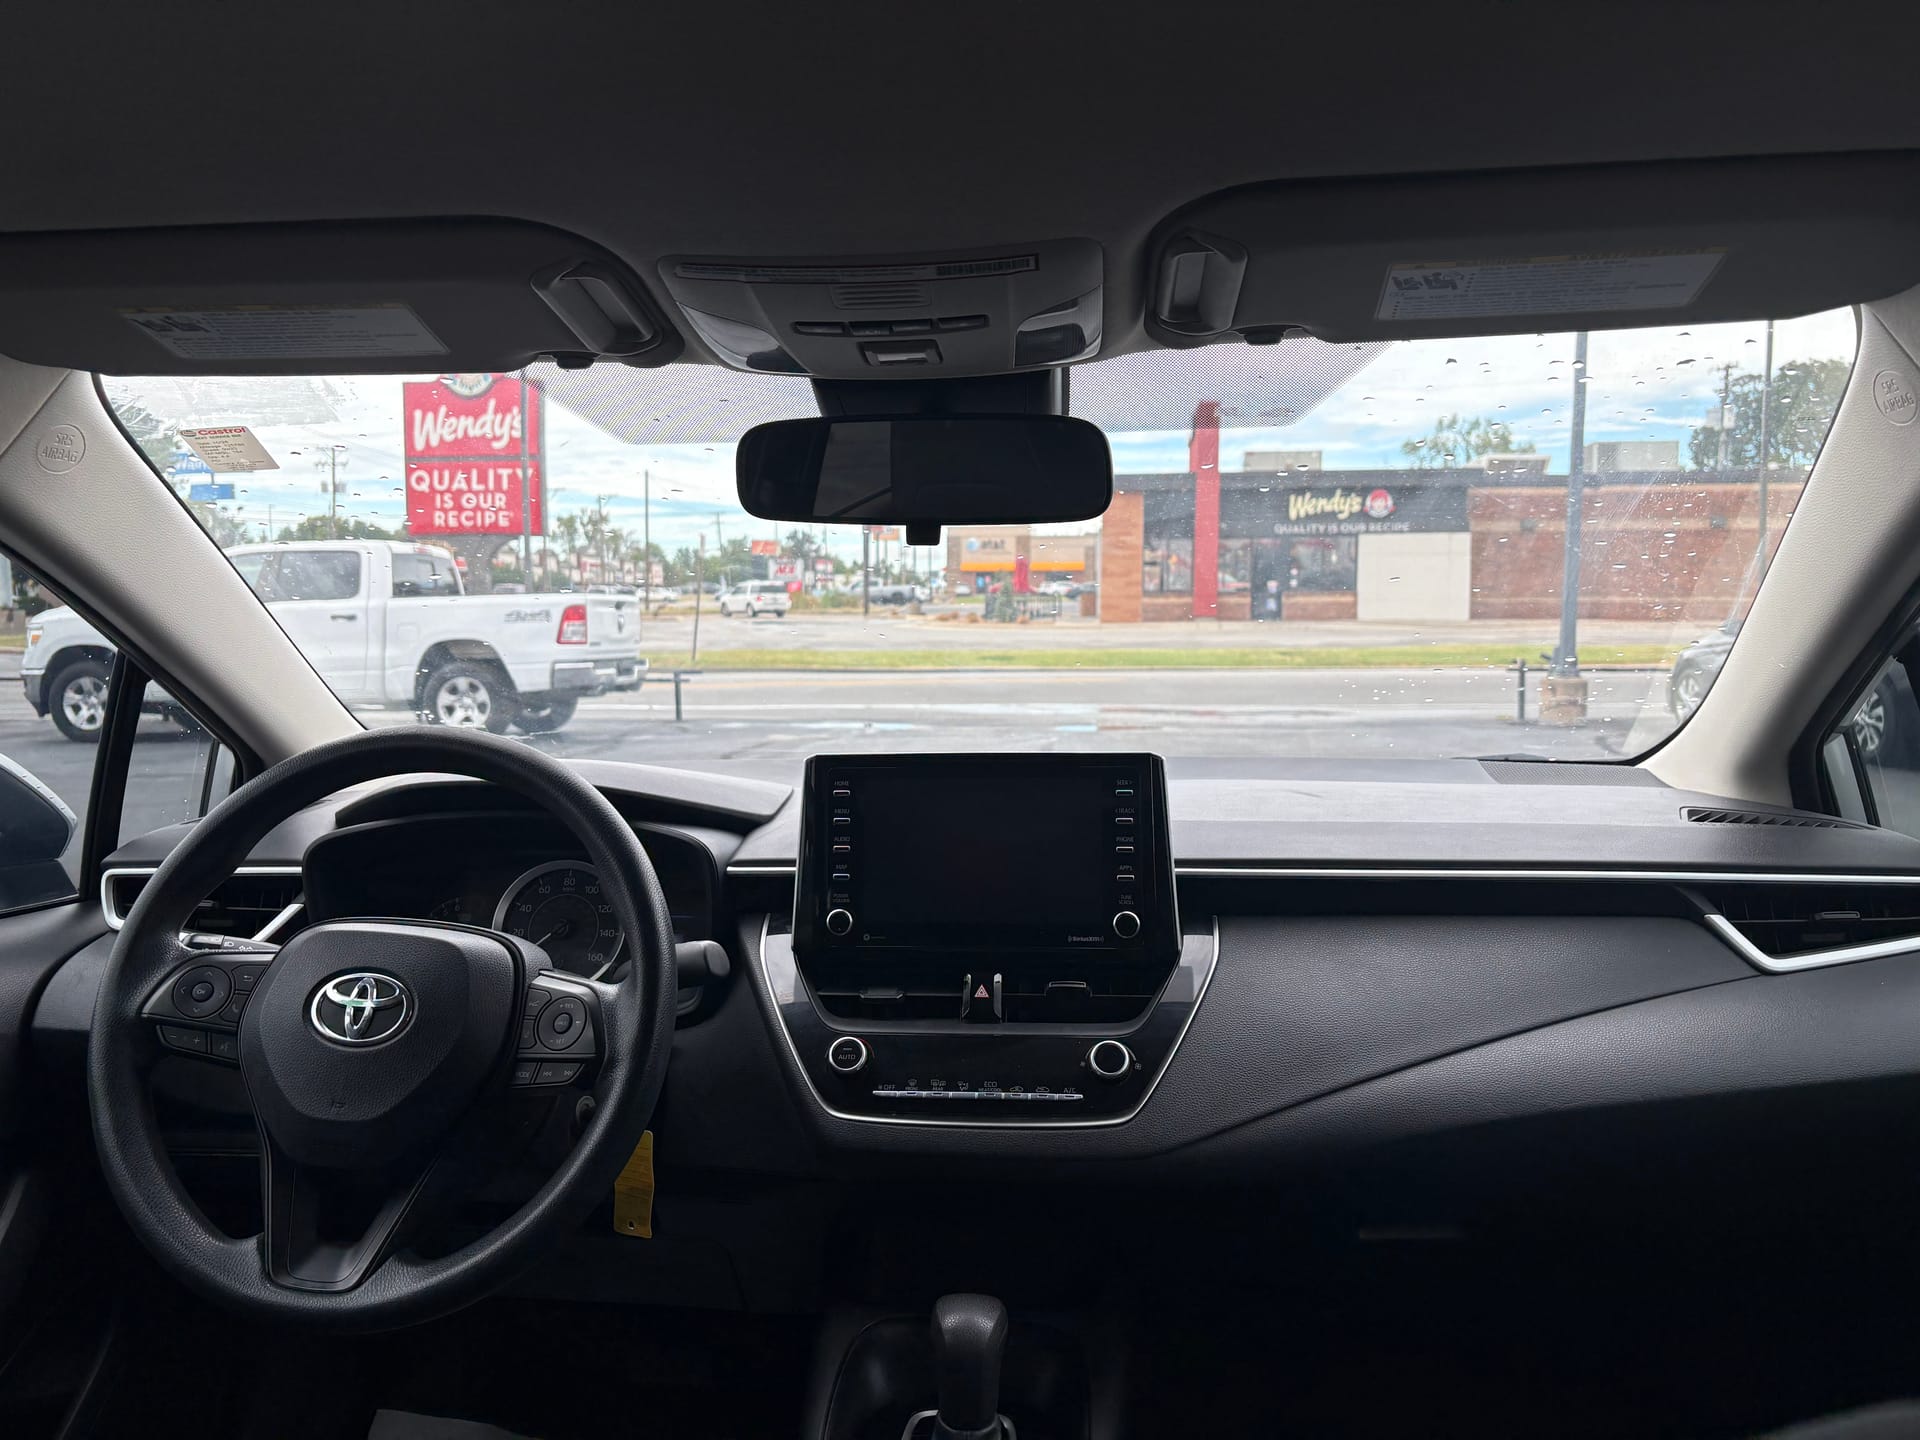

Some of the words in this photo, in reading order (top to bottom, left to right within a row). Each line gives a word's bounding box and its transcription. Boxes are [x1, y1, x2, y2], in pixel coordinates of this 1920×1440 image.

[198, 427, 246, 436] Castrol
[40, 445, 79, 464] AIRBAG
[434, 492, 454, 510] IS
[461, 492, 507, 510] OUR
[1288, 488, 1362, 521] Wendy's
[433, 510, 510, 528] RECIPE
[563, 877, 576, 886] 80
[538, 886, 551, 895] 60
[585, 885, 600, 895] 100
[519, 904, 532, 913] 40
[598, 904, 613, 913] 120
[513, 928, 525, 937] 20
[599, 928, 615, 937] 140
[587, 953, 603, 962] 160
[837, 1053, 856, 1061] AUTO
[883, 1083, 896, 1091] OFF
[983, 1080, 998, 1088] ECO
